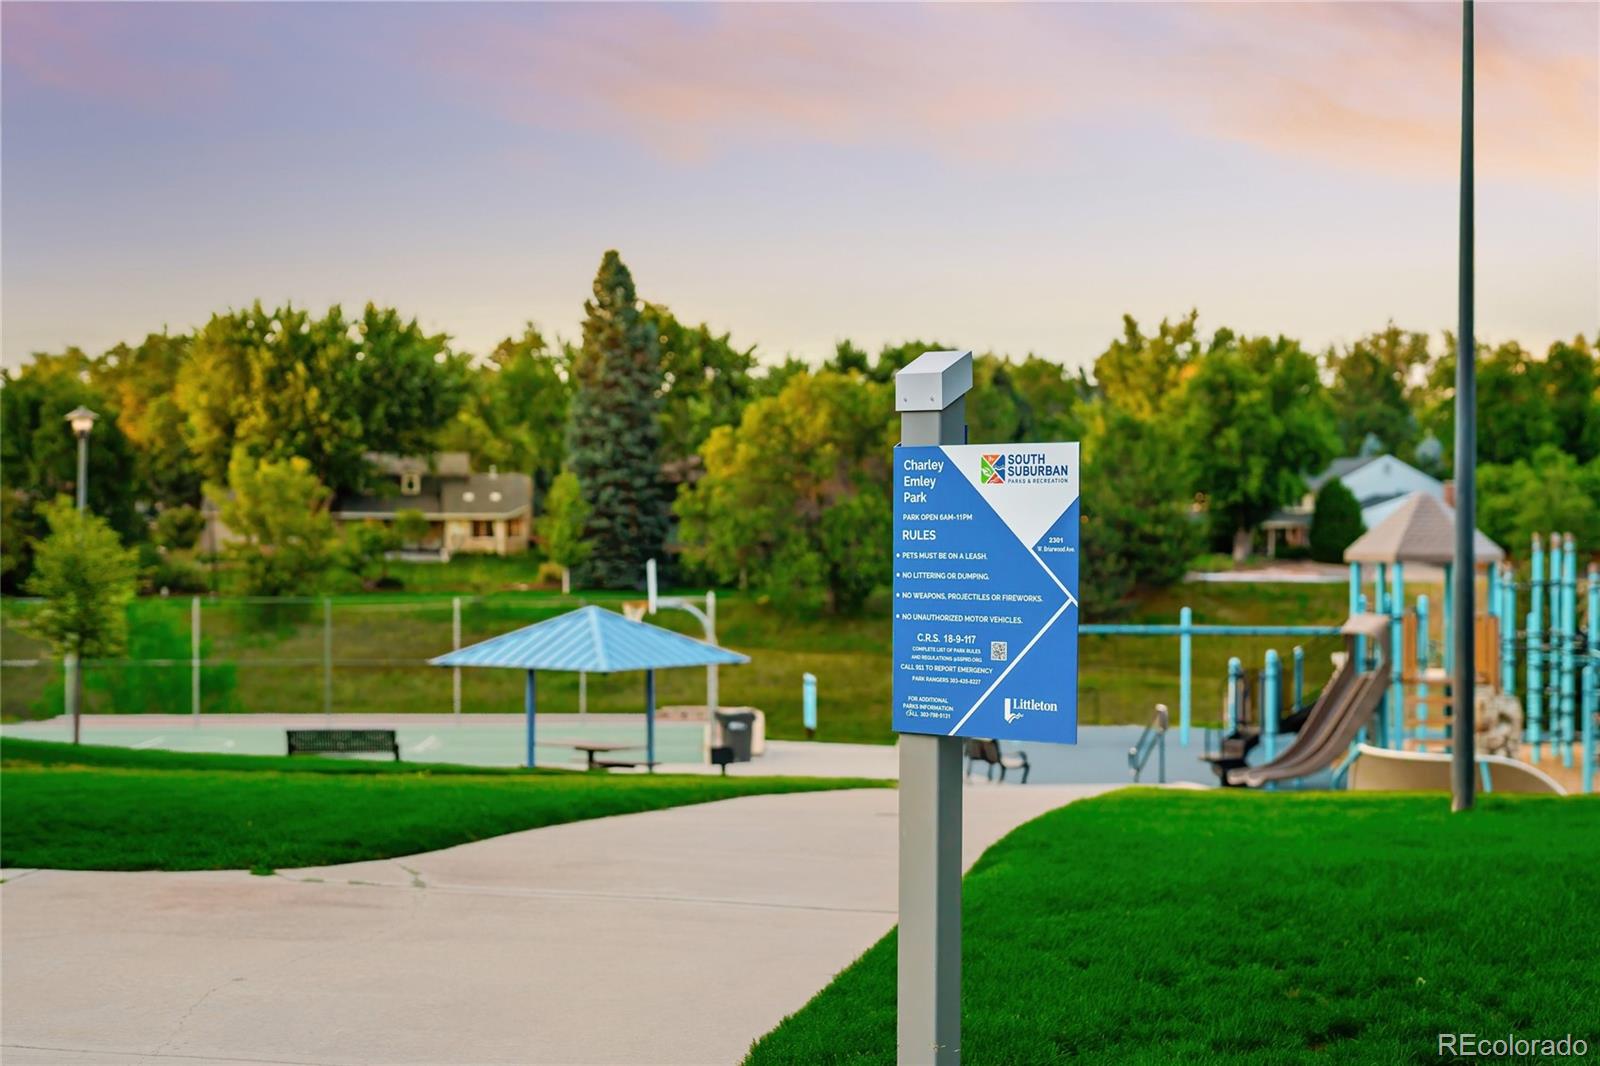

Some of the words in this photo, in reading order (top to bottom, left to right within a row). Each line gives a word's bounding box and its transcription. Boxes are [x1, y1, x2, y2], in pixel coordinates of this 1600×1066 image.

[1008, 453, 1046, 465] SOUTH
[903, 459, 944, 473] Charley
[1008, 465, 1068, 477] SUBURBAN
[903, 475, 936, 489] Emley
[903, 492, 927, 503] Park
[902, 513, 920, 521] PARK
[920, 513, 939, 521] OPEN
[939, 513, 973, 521] 6AM-11PM
[902, 529, 936, 541] RULES
[1048, 536, 1064, 544] 2301
[902, 551, 918, 559] PETS
[948, 552, 958, 560] ON
[959, 552, 964, 560] A
[965, 552, 988, 560] LEASH.
[902, 571, 912, 579] NO
[947, 572, 957, 580] OR
[957, 572, 990, 580] DUMPING.
[947, 593, 990, 601] PROJECTILES
[1002, 594, 1043, 602] FIREWORKS.
[913, 614, 963, 622] UNAUTHORIZED
[964, 615, 989, 623] MOTOR
[989, 616, 1023, 624] VEHICLES.
[917, 633, 940, 642] C.R.S.
[943, 634, 977, 644] 18-9-117
[957, 666, 993, 674] EMERGENCY
[918, 696, 949, 704] ADDITIONAL
[1013, 698, 1057, 712] Littleton
